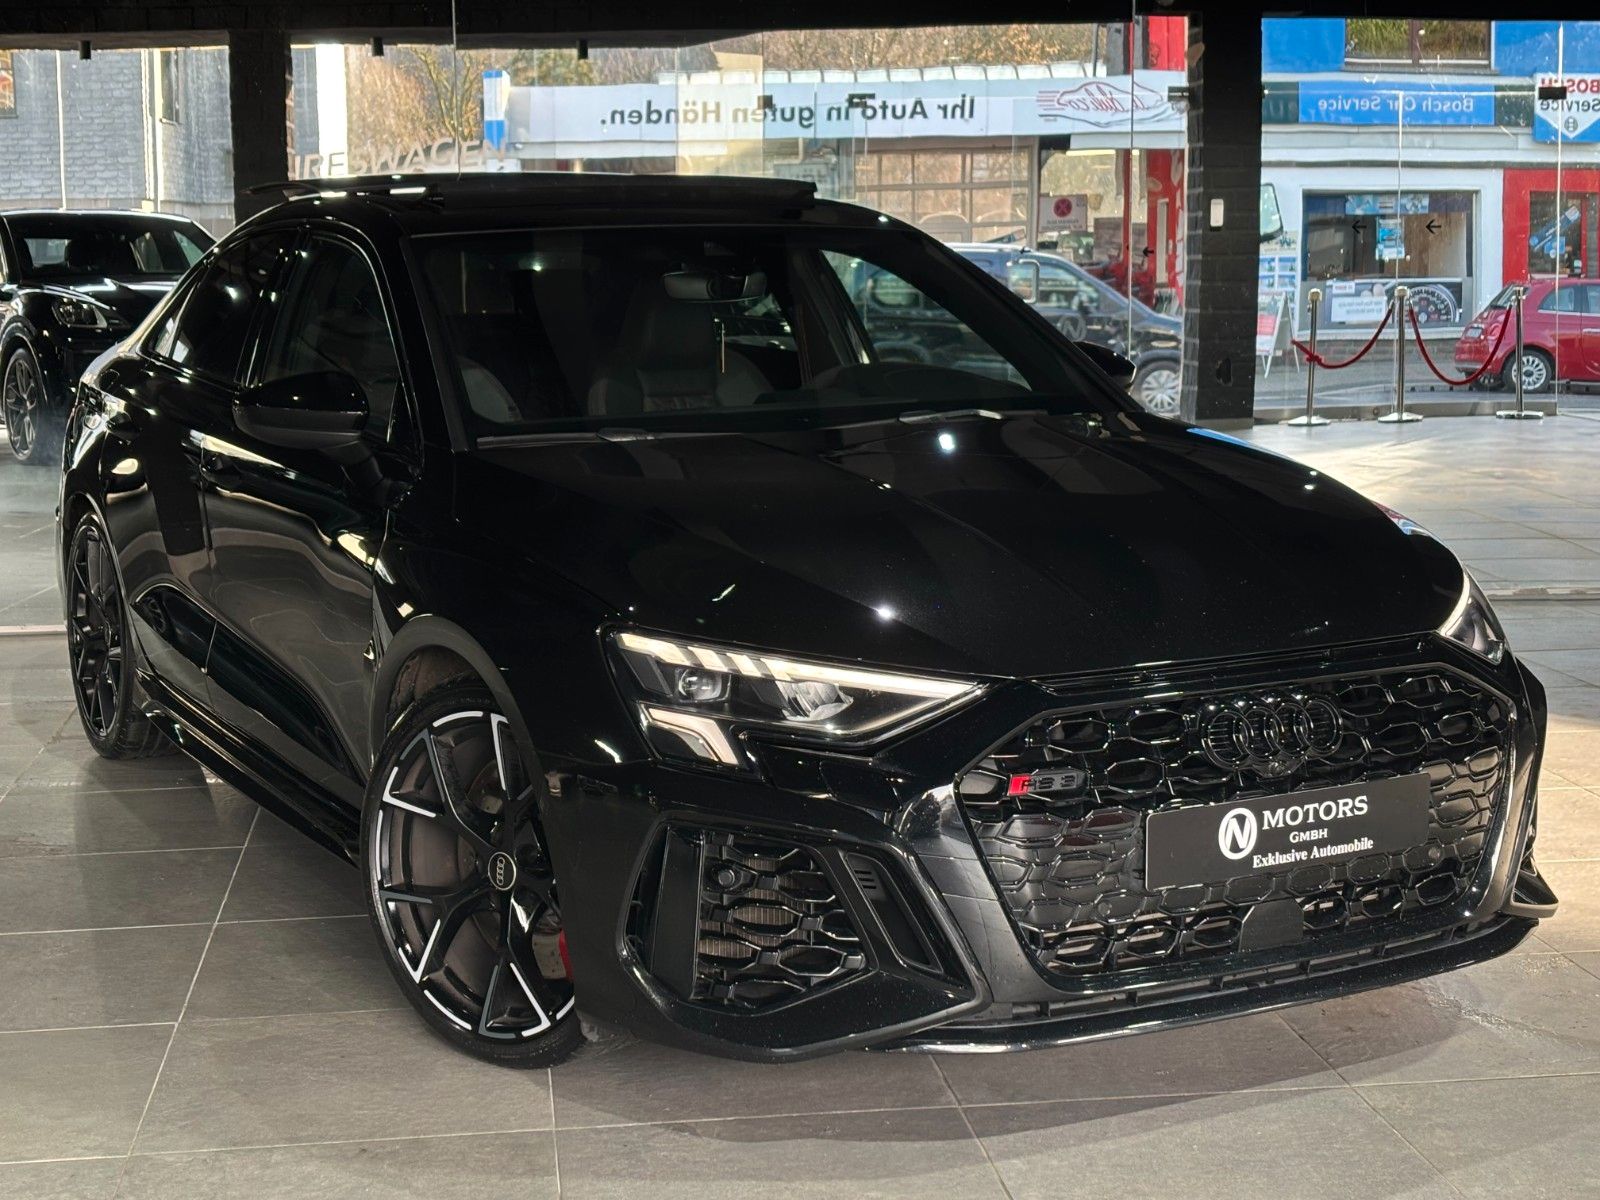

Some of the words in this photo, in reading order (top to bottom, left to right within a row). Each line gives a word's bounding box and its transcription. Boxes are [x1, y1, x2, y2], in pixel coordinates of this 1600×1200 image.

[1262, 795, 1368, 830] MOTORS
[1289, 828, 1328, 844] GMBH
[1253, 849, 1308, 868] Exklusive
[1310, 837, 1374, 859] Automobile
